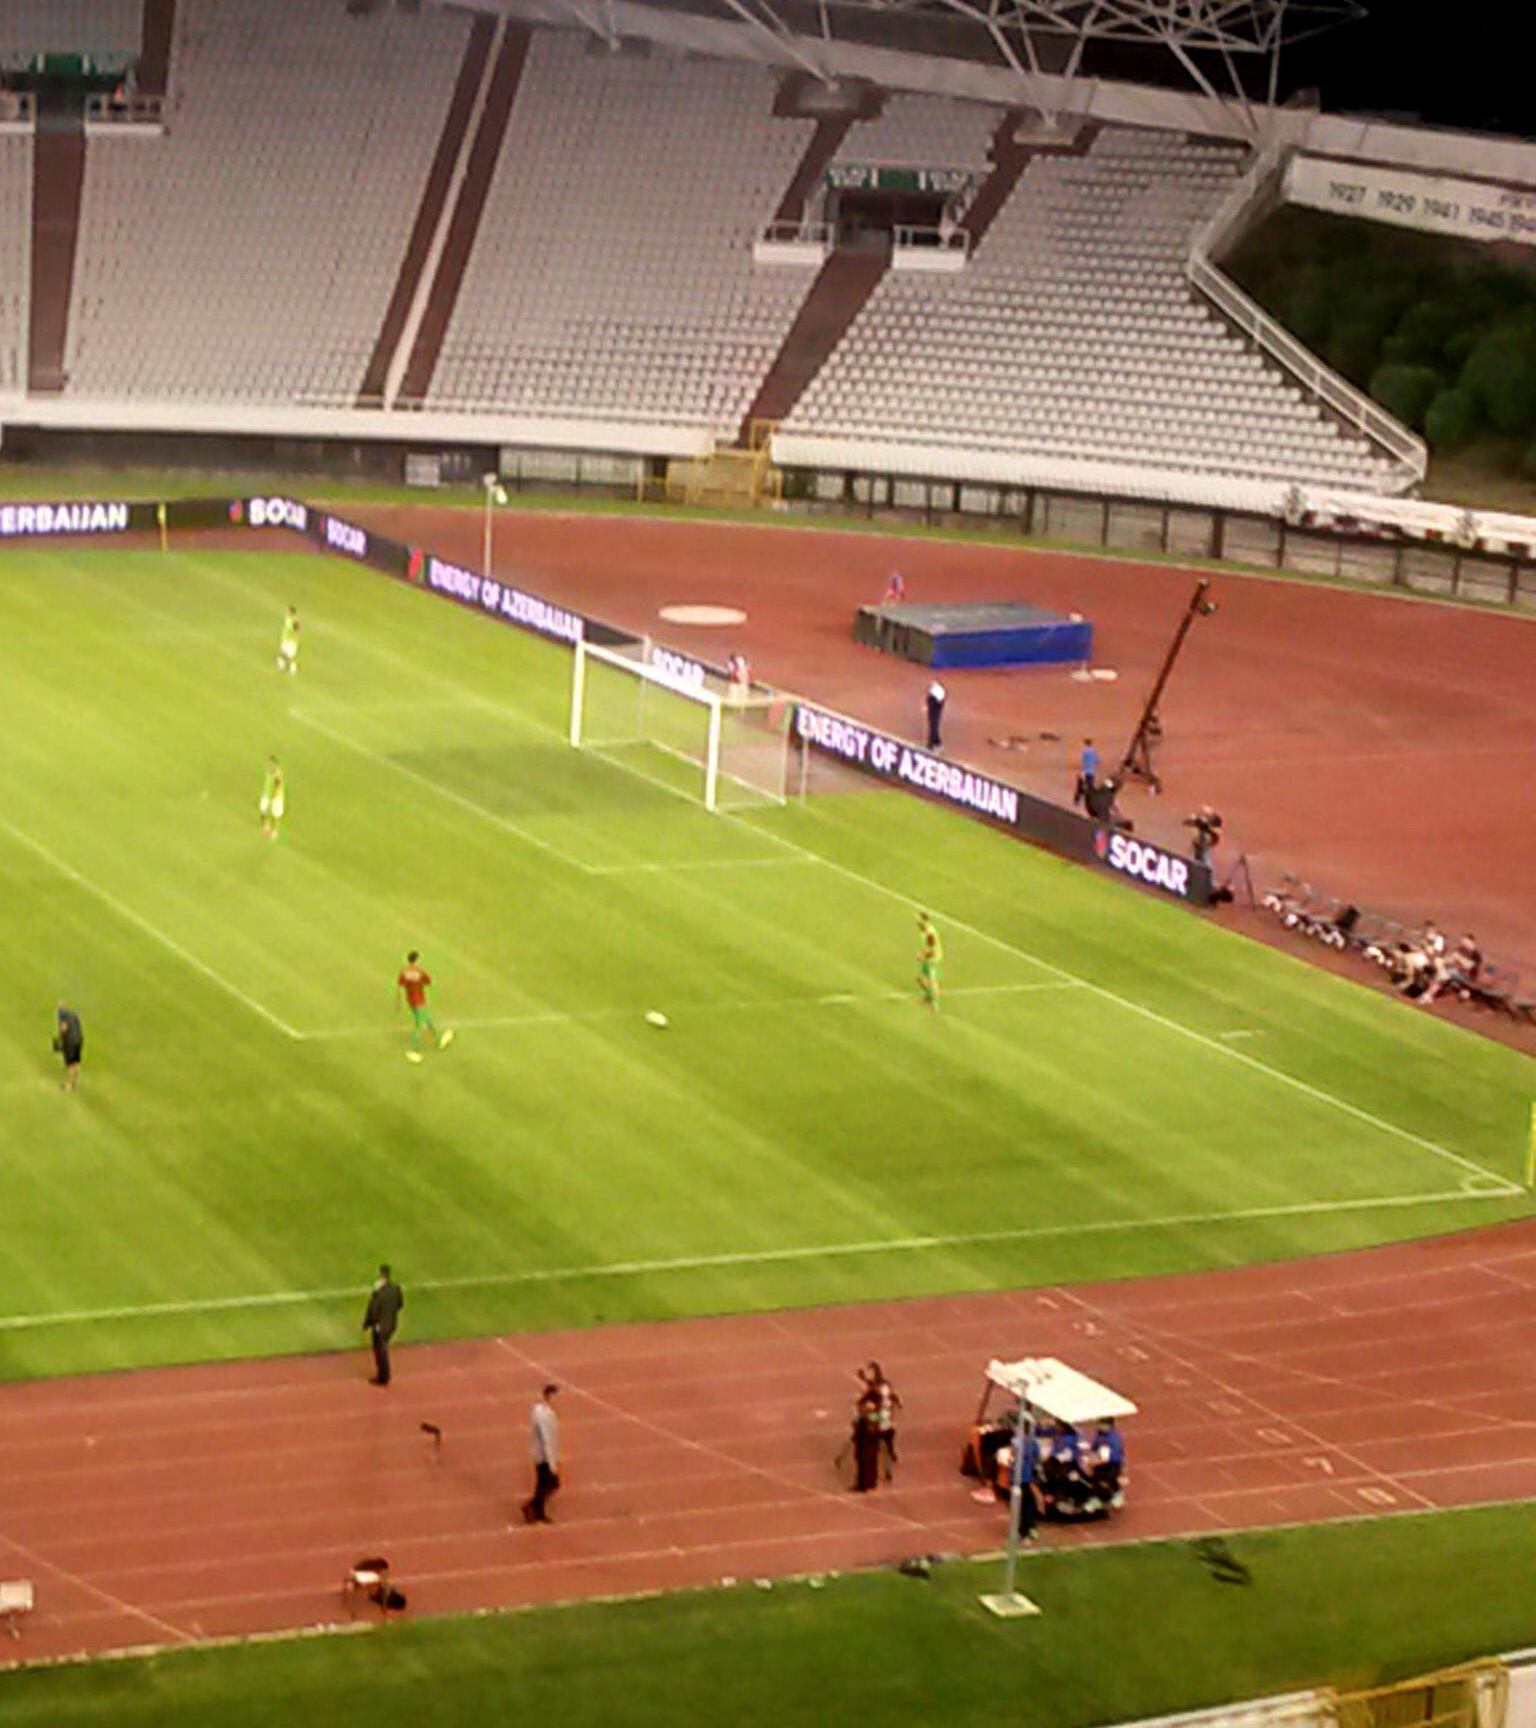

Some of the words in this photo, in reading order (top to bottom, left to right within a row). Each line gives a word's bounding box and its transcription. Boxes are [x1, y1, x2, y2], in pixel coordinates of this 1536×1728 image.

[326, 516, 367, 557] SOCAR
[429, 557, 481, 601] ENERGY
[481, 579, 500, 610] OF
[501, 588, 584, 643] AZERBAIJAN
[651, 646, 705, 690] SOCAR
[796, 706, 869, 760] ENERGY
[871, 736, 898, 773] OF
[898, 748, 1019, 824] AZERBAIJAN
[1108, 833, 1188, 896] SOCAR
